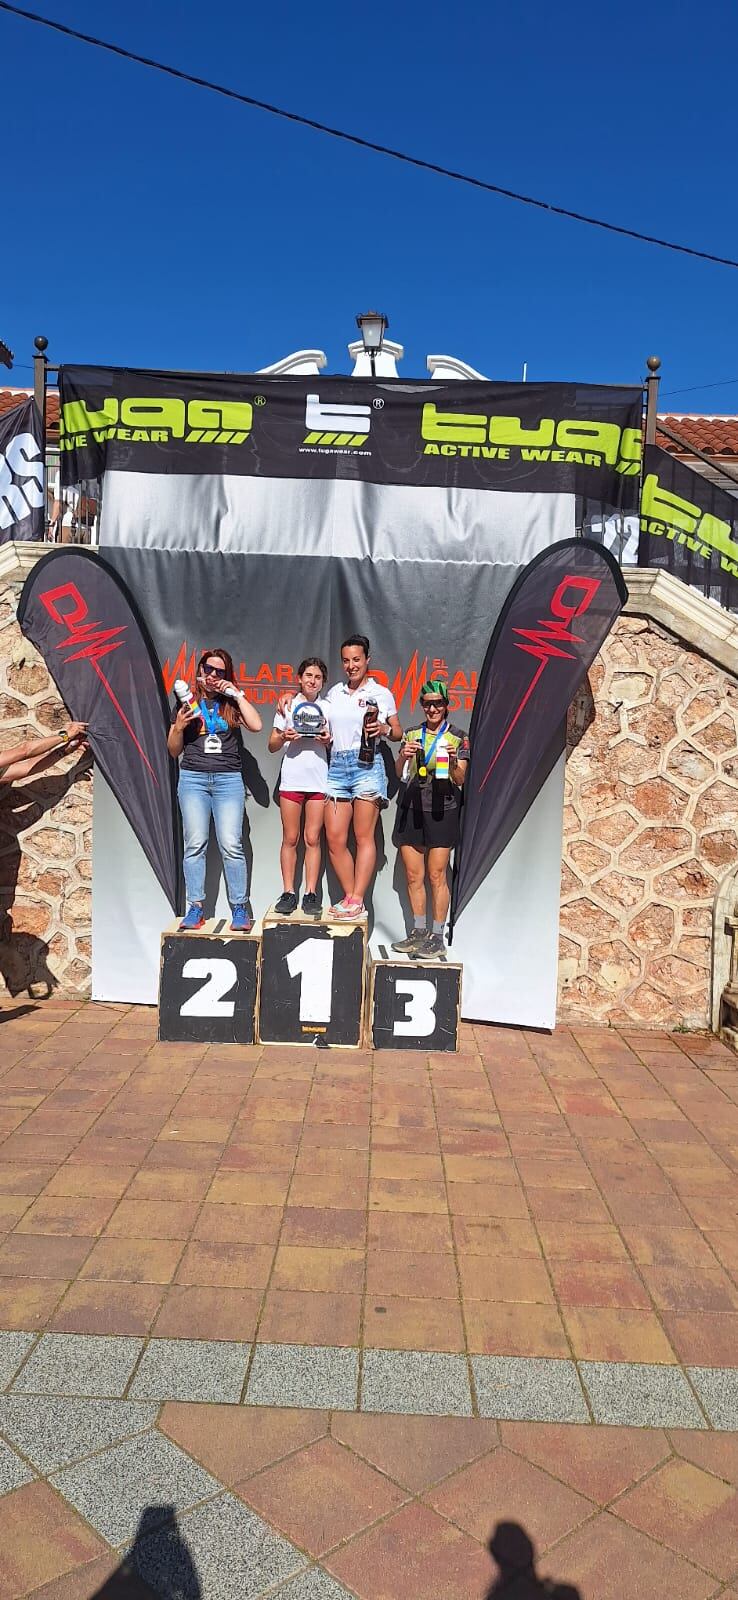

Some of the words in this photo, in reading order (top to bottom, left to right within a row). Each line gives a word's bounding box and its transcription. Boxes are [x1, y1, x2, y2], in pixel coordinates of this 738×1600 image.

[60, 434, 88, 451] IVE
[93, 427, 169, 443] WEAR
[299, 447, 372, 457] www.tugawear.com
[424, 443, 511, 460] ACTIVE
[521, 449, 602, 467] WEAR
[238, 662, 294, 684] LAR
[432, 658, 448, 669] EL
[180, 957, 238, 1018] 2
[286, 937, 335, 1023] 1
[393, 979, 438, 1038] 3
